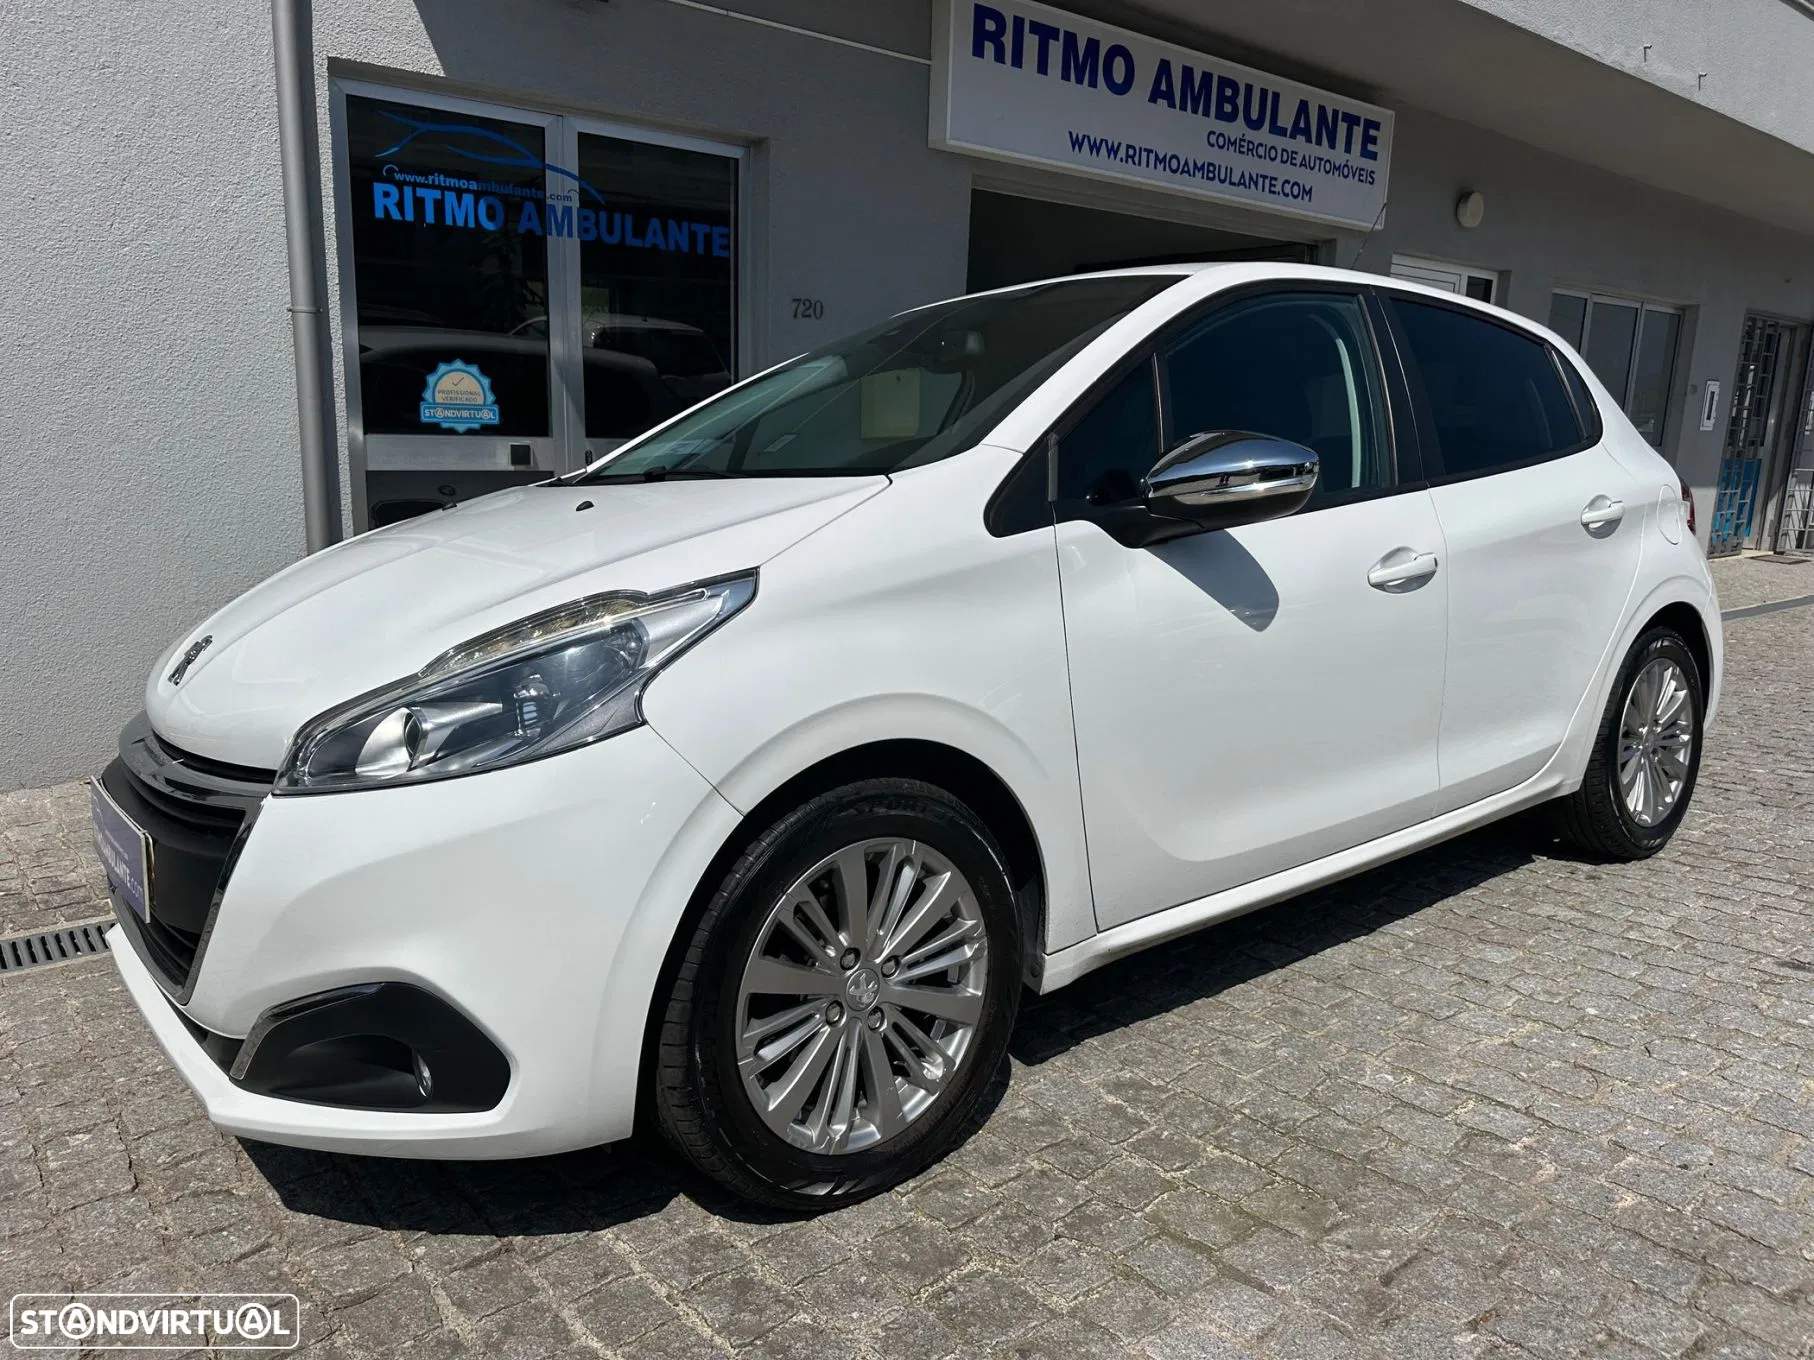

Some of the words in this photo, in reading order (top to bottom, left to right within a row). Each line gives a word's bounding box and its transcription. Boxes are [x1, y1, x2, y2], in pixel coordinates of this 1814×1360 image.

[972, 3, 1135, 96] RITMO
[1148, 58, 1380, 161] AMBULANTE
[1068, 130, 1313, 203] WWW.RITMOAMBULANTE.COM
[1206, 130, 1278, 162] COMÉRCIO
[1280, 150, 1298, 167] DE
[1298, 155, 1376, 186] AUTOMÓVEIS
[373, 182, 505, 231] RITMO
[517, 201, 730, 258] AMBULANTE
[792, 298, 824, 320] 720
[424, 407, 496, 420] STANDVIRTUAL
